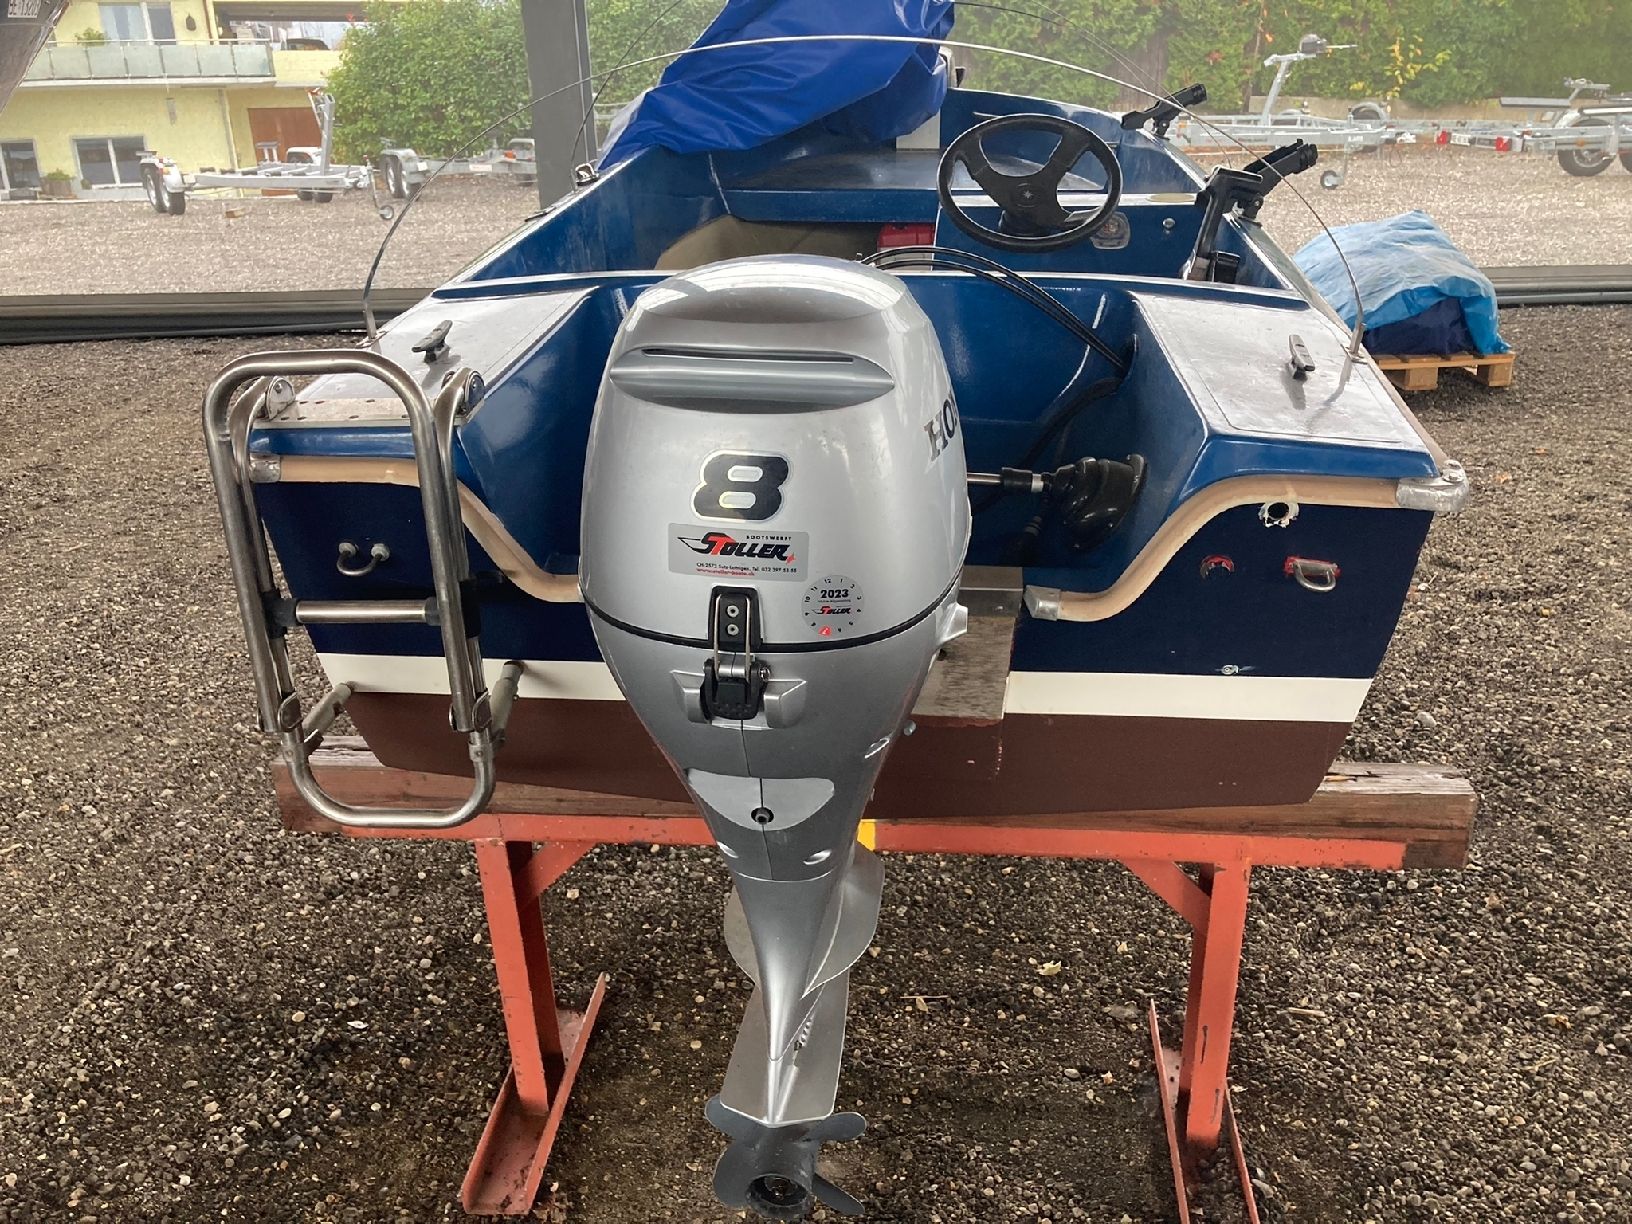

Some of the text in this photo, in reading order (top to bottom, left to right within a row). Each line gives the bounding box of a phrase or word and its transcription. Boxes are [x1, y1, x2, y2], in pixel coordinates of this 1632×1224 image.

[690, 449, 789, 523] 8
[678, 531, 791, 561] STOLLER
[820, 589, 849, 599] 2023
